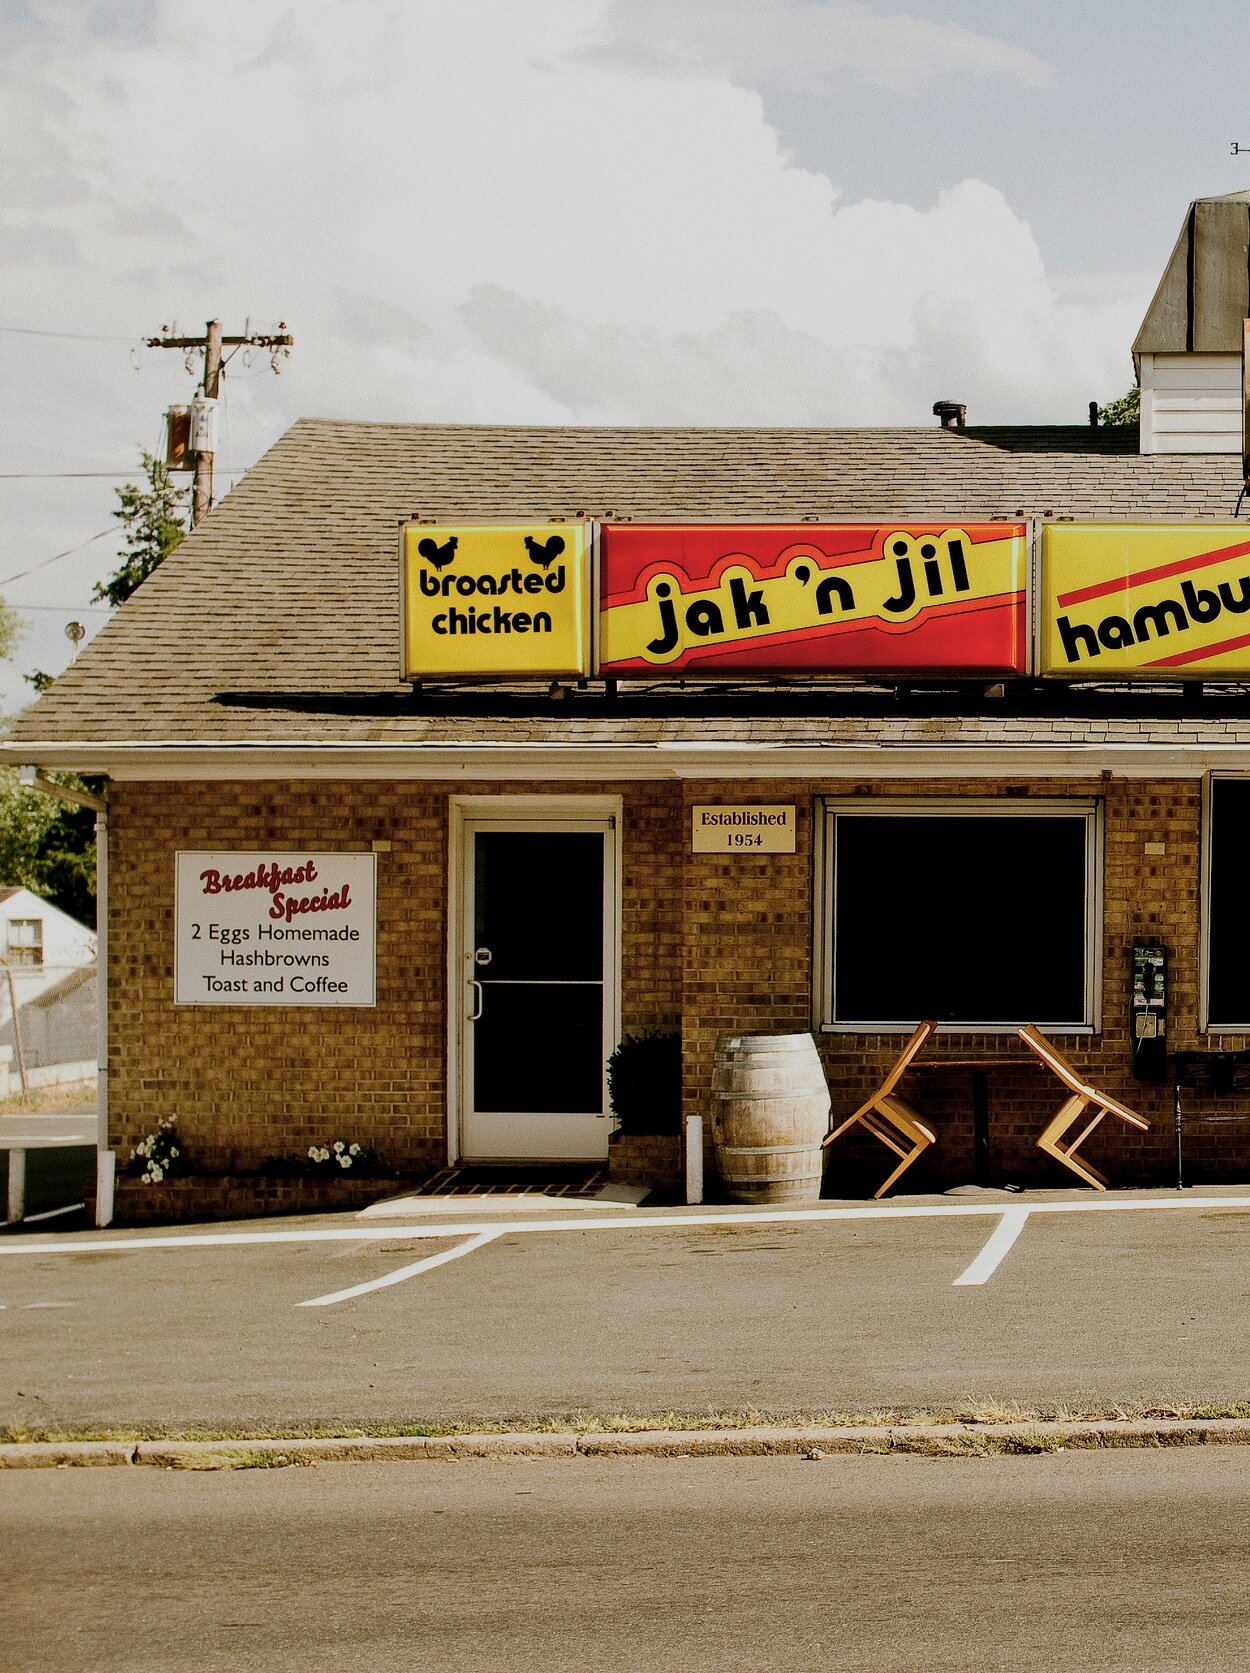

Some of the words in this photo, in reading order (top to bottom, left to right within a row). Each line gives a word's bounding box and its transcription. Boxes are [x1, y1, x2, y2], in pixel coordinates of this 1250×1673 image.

[420, 565, 566, 597] broasted
[645, 577, 771, 655] jak
[793, 565, 857, 614] 'n
[883, 539, 971, 612] jil
[431, 606, 552, 635] chicken
[701, 811, 787, 826] Established
[727, 833, 763, 847] 1954
[200, 860, 318, 894] Breakfast
[269, 884, 352, 923] Special
[191, 923, 202, 940] 2
[209, 924, 250, 945] Eggs
[258, 924, 360, 941] Homemade
[220, 949, 330, 967] Hashbrowns
[203, 975, 248, 992] Toast
[253, 976, 284, 992] and
[290, 976, 348, 993] Coffee
